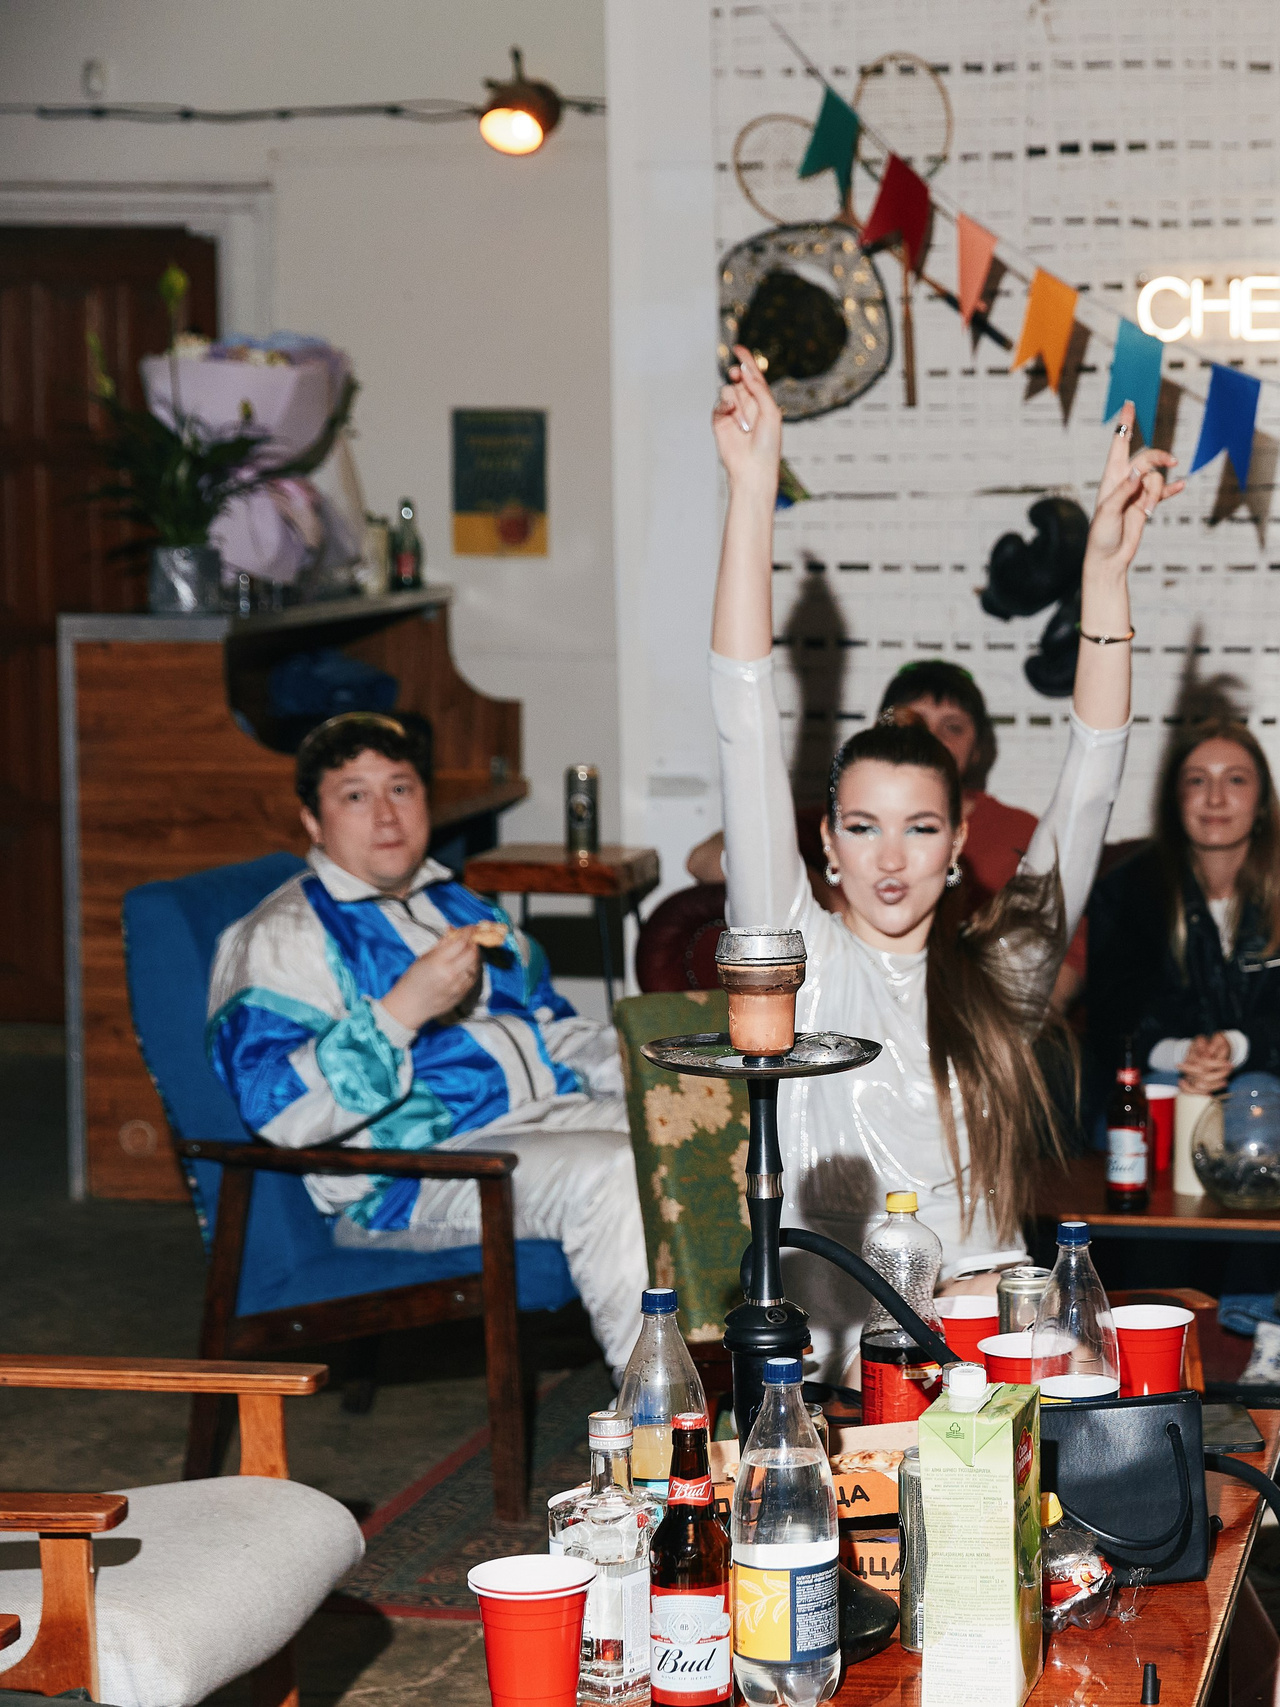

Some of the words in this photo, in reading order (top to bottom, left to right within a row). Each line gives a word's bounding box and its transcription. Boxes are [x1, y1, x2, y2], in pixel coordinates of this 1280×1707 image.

[673, 1481, 706, 1499] Bud
[837, 1484, 870, 1508] ЦА
[653, 1645, 717, 1673] Bud
